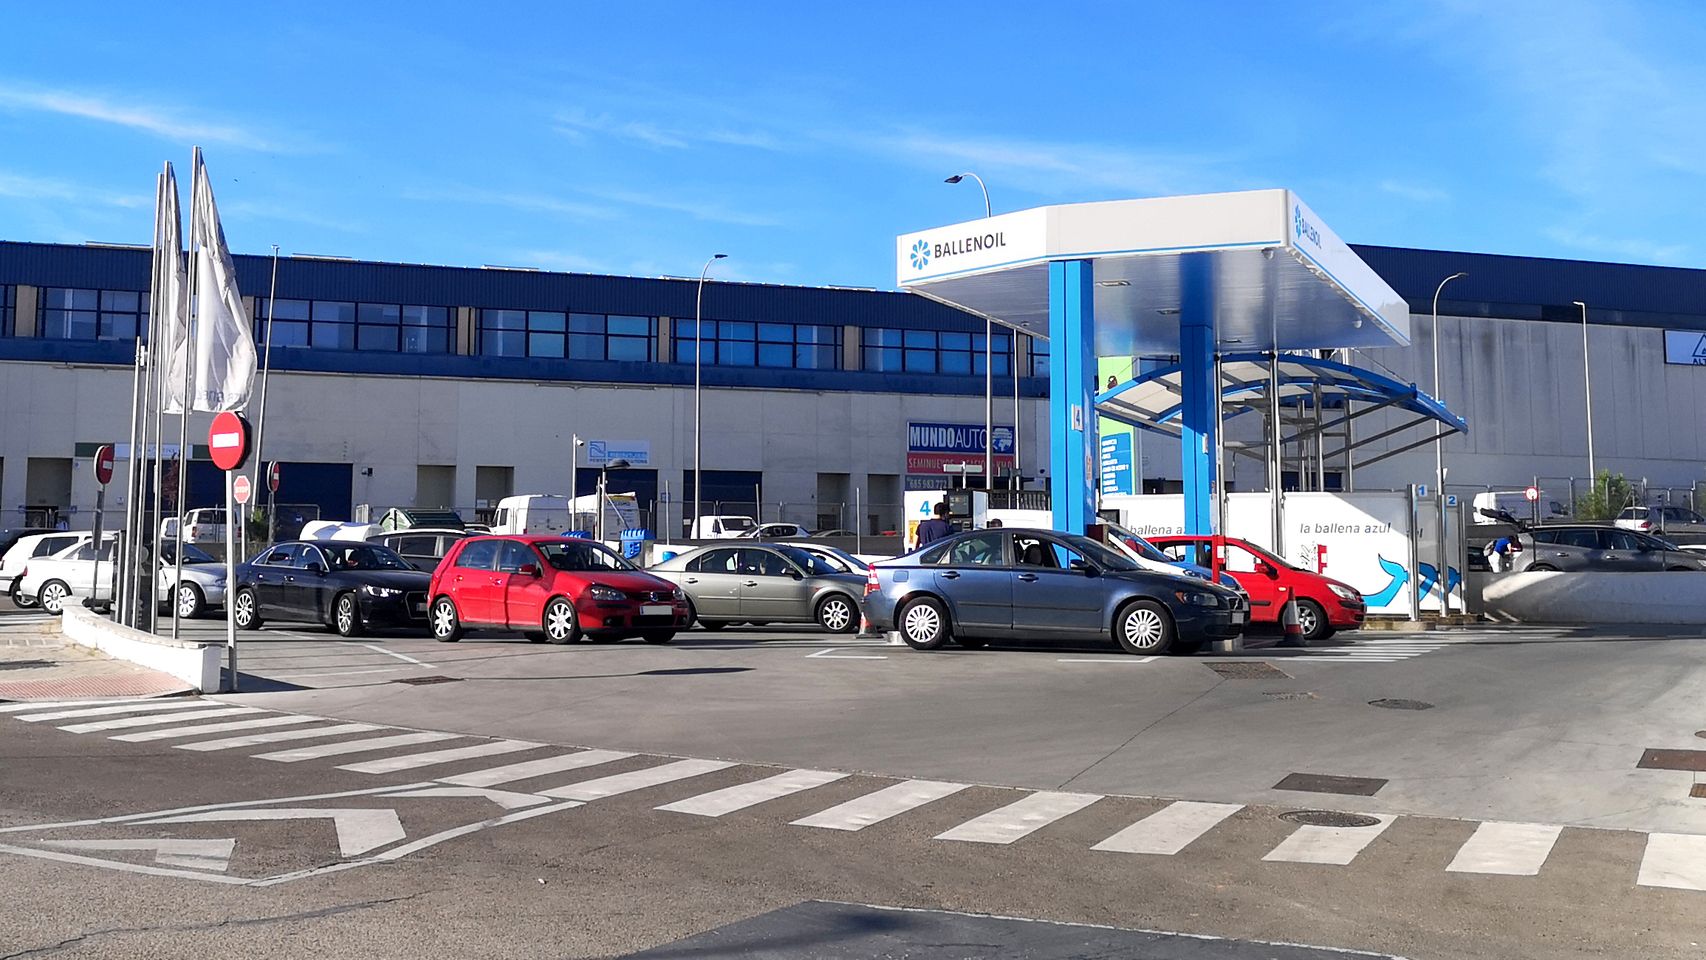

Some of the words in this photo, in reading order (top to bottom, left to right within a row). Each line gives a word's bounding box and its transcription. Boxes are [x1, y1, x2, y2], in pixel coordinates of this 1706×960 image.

[934, 231, 1007, 259] BALLENOIL
[1418, 485, 1425, 496] 1
[1448, 496, 1457, 505] 2
[920, 501, 931, 516] 4
[1300, 523, 1310, 533] la
[1315, 523, 1360, 534] ballena
[1364, 522, 1391, 534] azul
